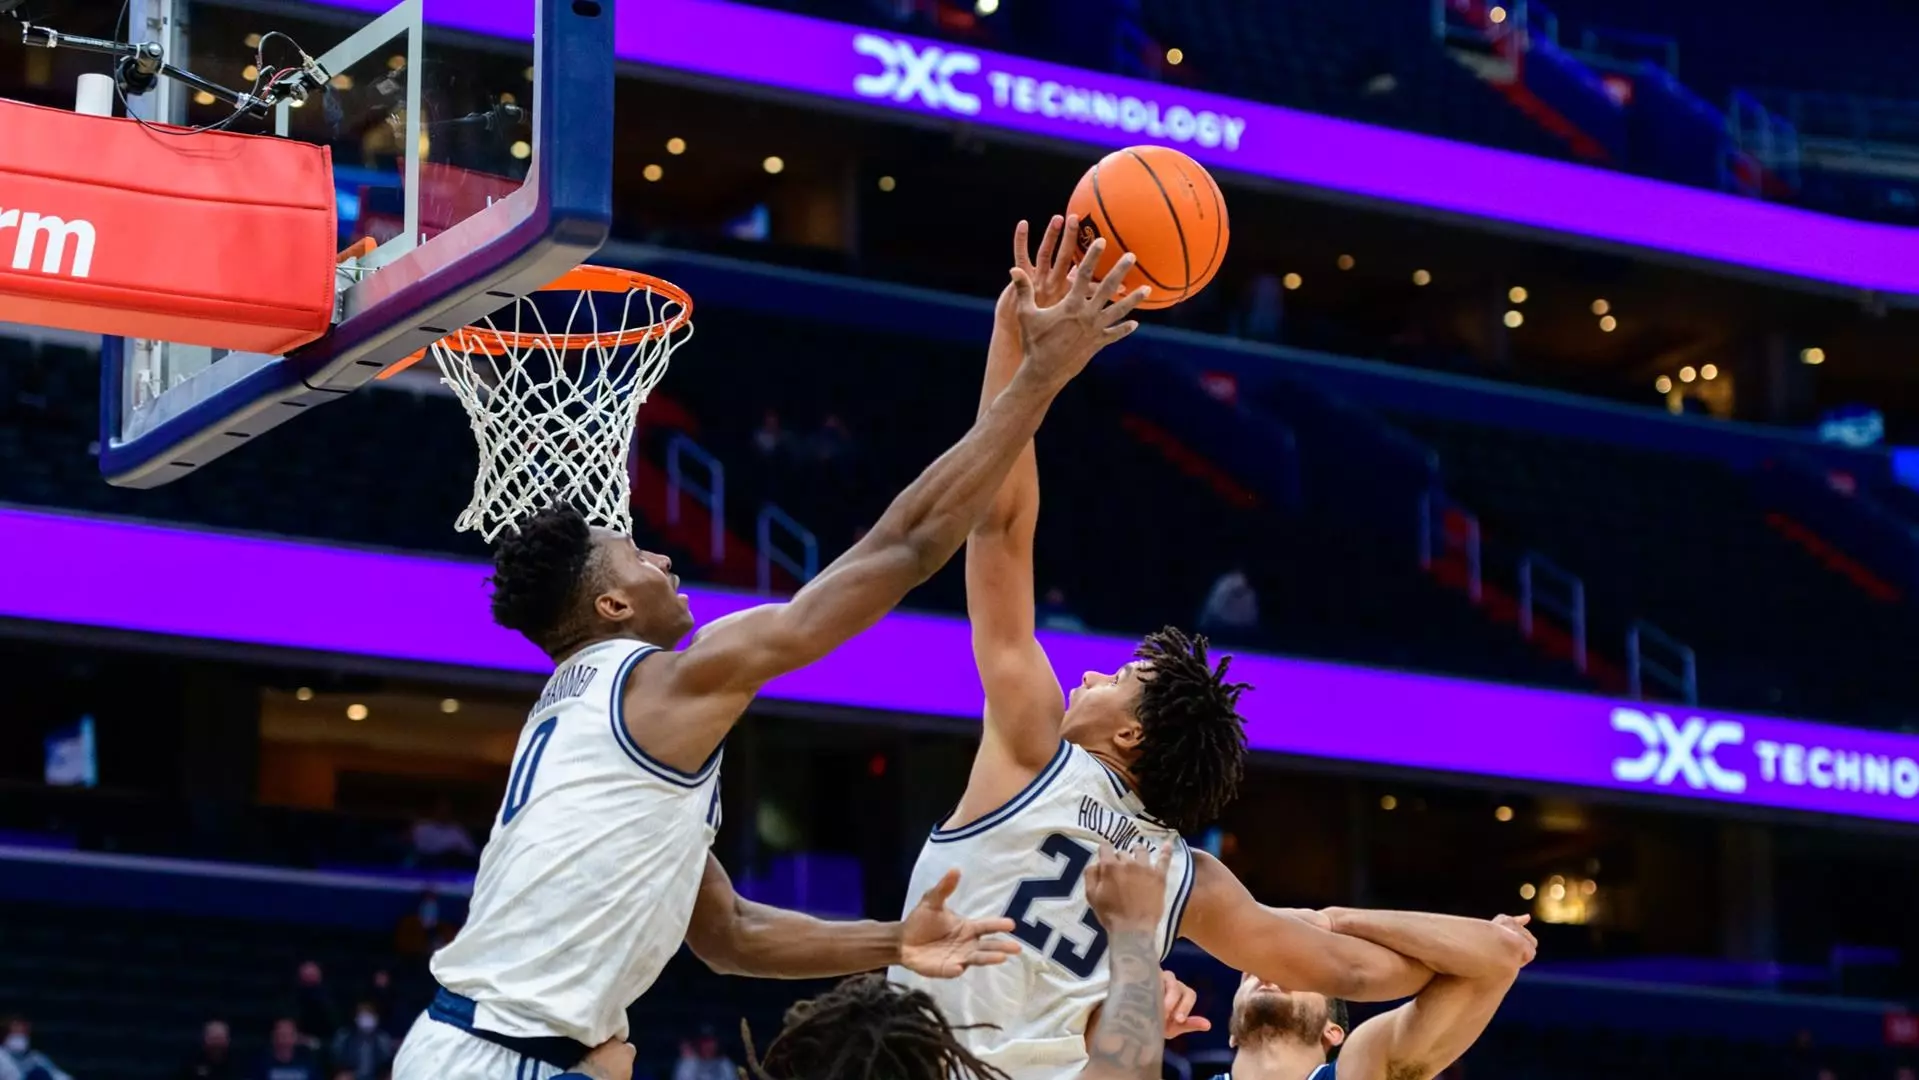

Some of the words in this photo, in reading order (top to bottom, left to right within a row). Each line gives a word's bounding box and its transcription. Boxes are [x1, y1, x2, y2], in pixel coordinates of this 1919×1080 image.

[853, 34, 981, 115] DXC
[988, 70, 1246, 151] TECHNOLOGY
[502, 715, 558, 826] 0
[1611, 707, 1746, 794] DXC
[1754, 739, 1919, 800] TECHNO
